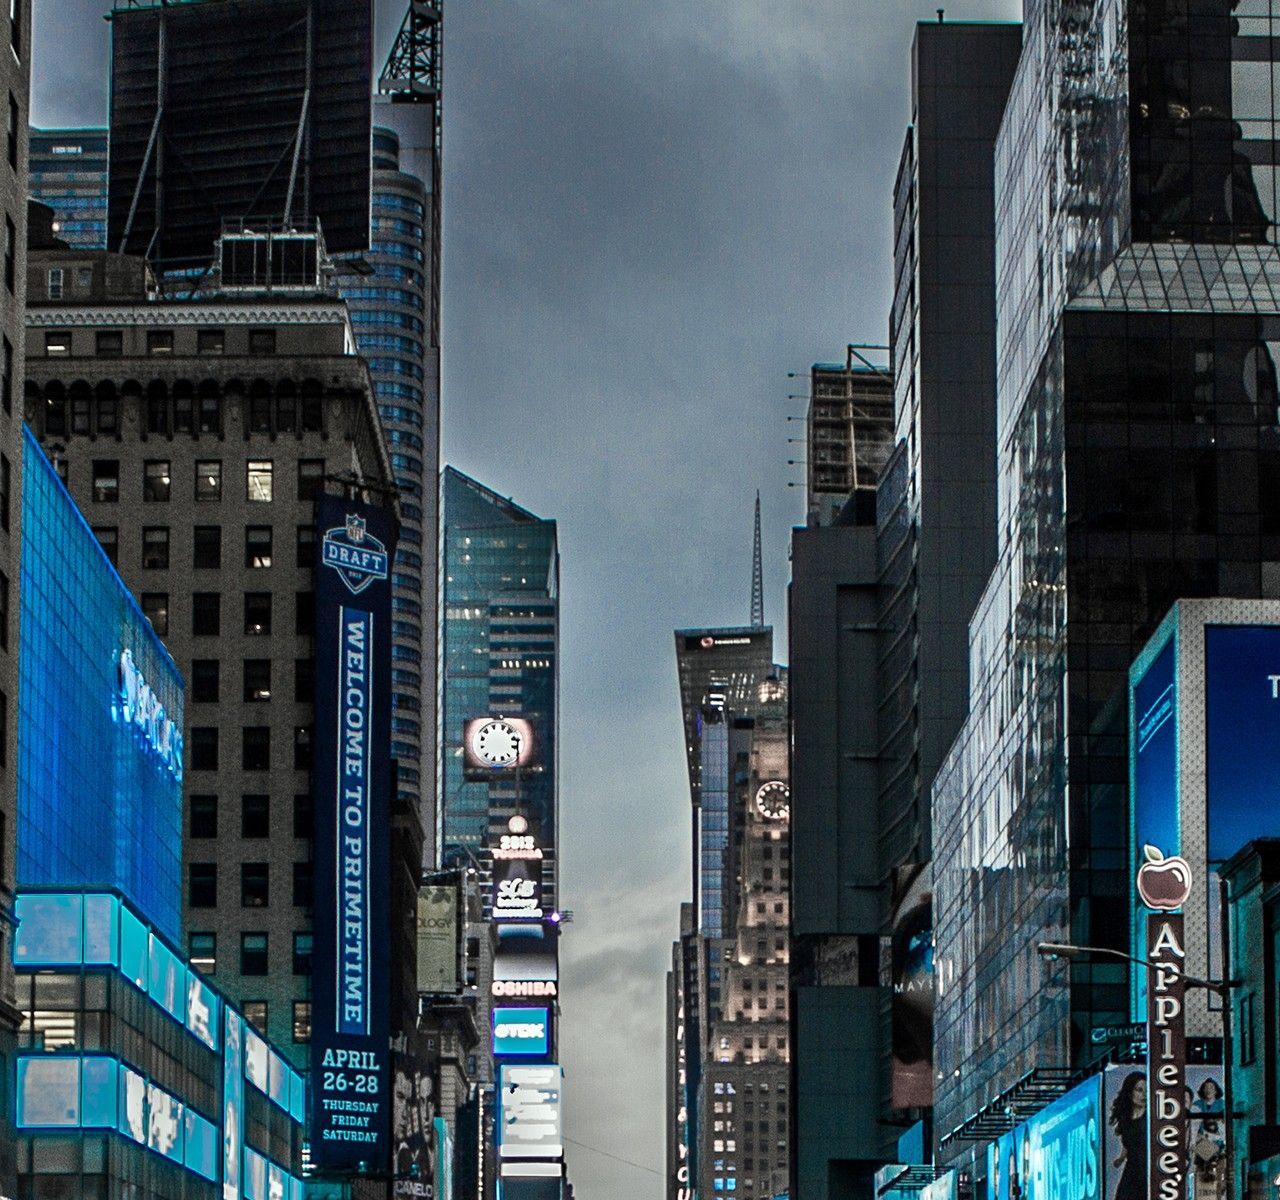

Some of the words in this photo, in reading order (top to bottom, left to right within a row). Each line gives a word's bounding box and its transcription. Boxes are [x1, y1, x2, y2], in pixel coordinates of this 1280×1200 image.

[328, 545, 382, 569] DRAFT
[345, 620, 365, 776] WELCOME
[345, 786, 363, 827] TO
[344, 835, 363, 1024] PRIMETIME
[492, 981, 556, 996] OSHIBA
[322, 1048, 380, 1070] APRIL
[323, 1072, 379, 1094] 26-28
[322, 1099, 380, 1113] THURSDAY
[331, 1115, 370, 1127] FRIDAY
[322, 1130, 378, 1143] SATURDAY
